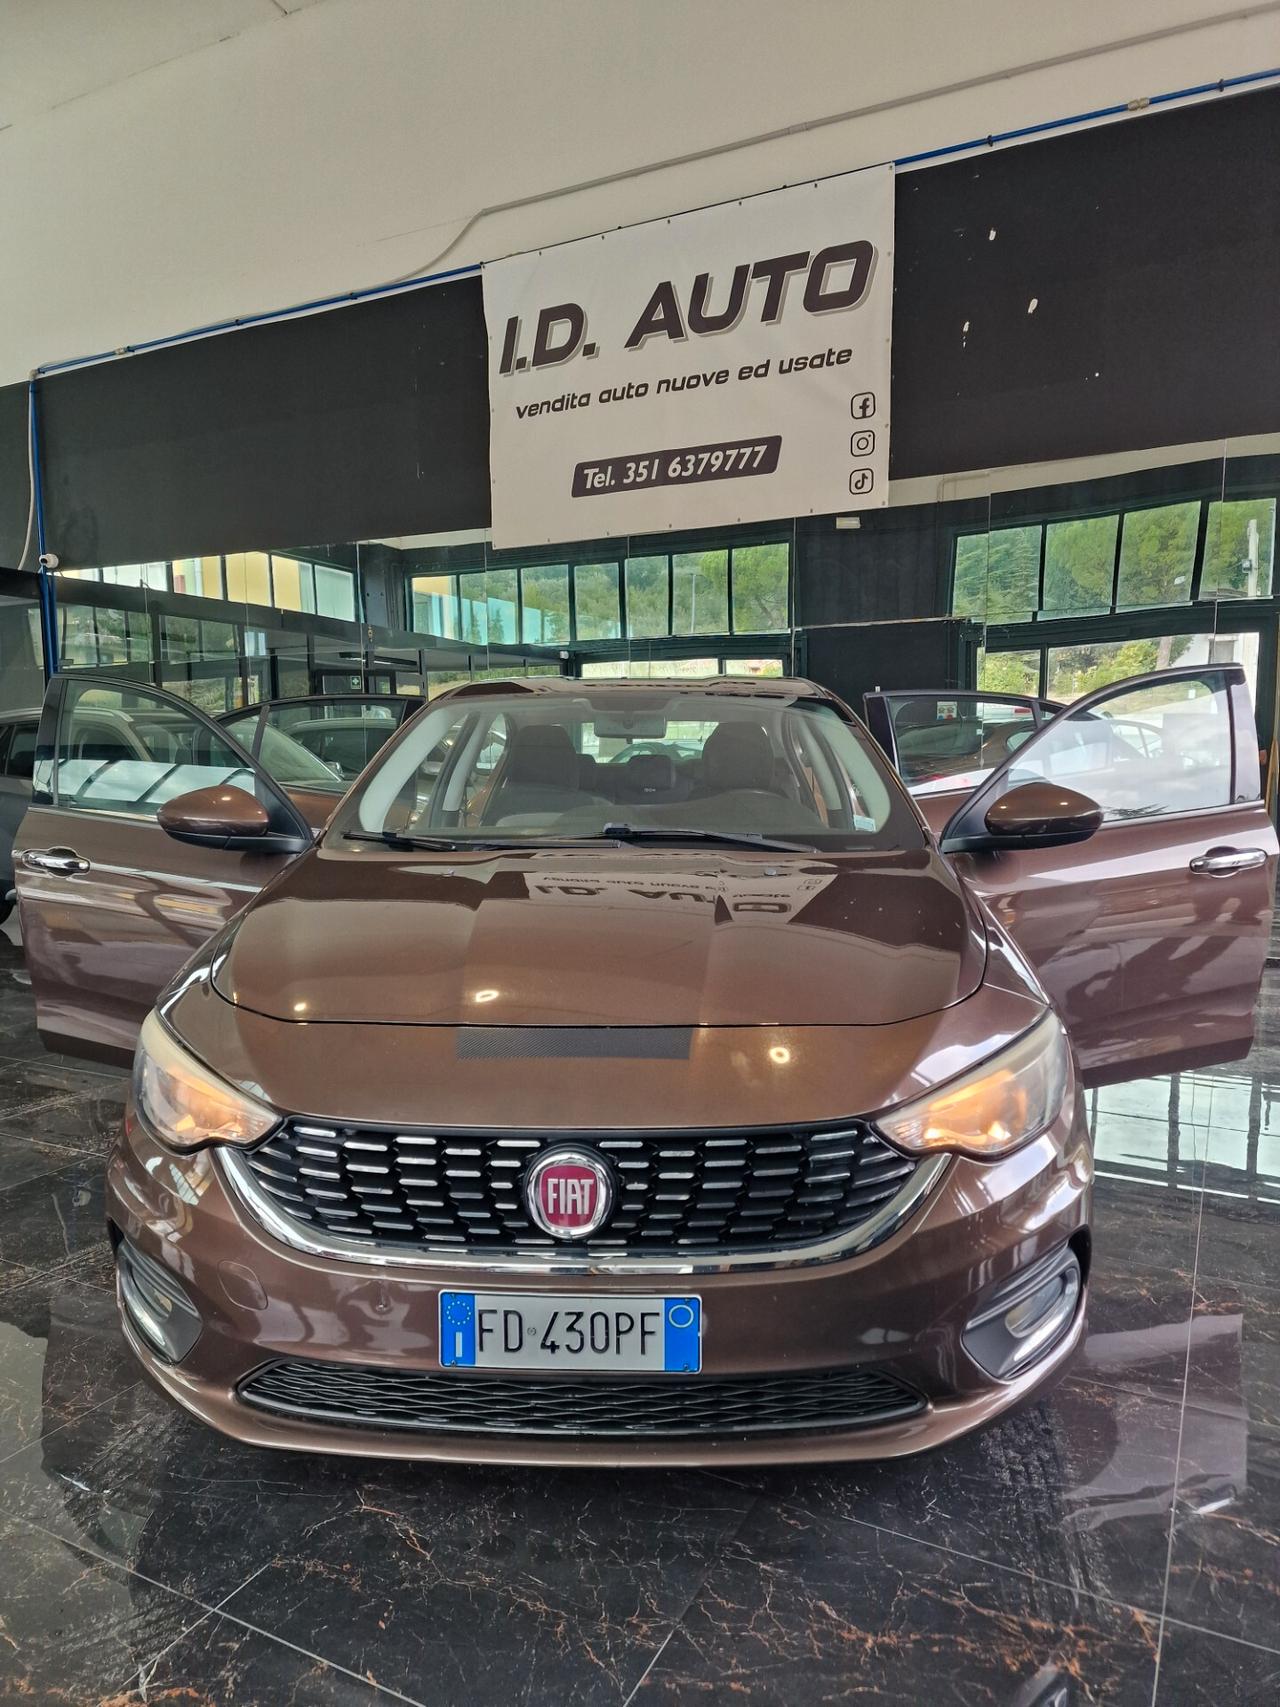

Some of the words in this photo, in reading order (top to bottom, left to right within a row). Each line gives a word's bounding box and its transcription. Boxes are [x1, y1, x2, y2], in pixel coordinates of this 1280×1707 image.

[499, 303, 600, 376] I.D.
[624, 240, 878, 351] AUTO
[516, 393, 590, 419] vendita
[599, 382, 649, 404] auto
[656, 369, 730, 394] nuove
[737, 360, 771, 380] ed
[778, 347, 853, 375] usate
[584, 466, 615, 488] Tel.
[623, 459, 659, 484] 351
[667, 445, 767, 478] 6379777
[547, 1178, 595, 1215] FIAT
